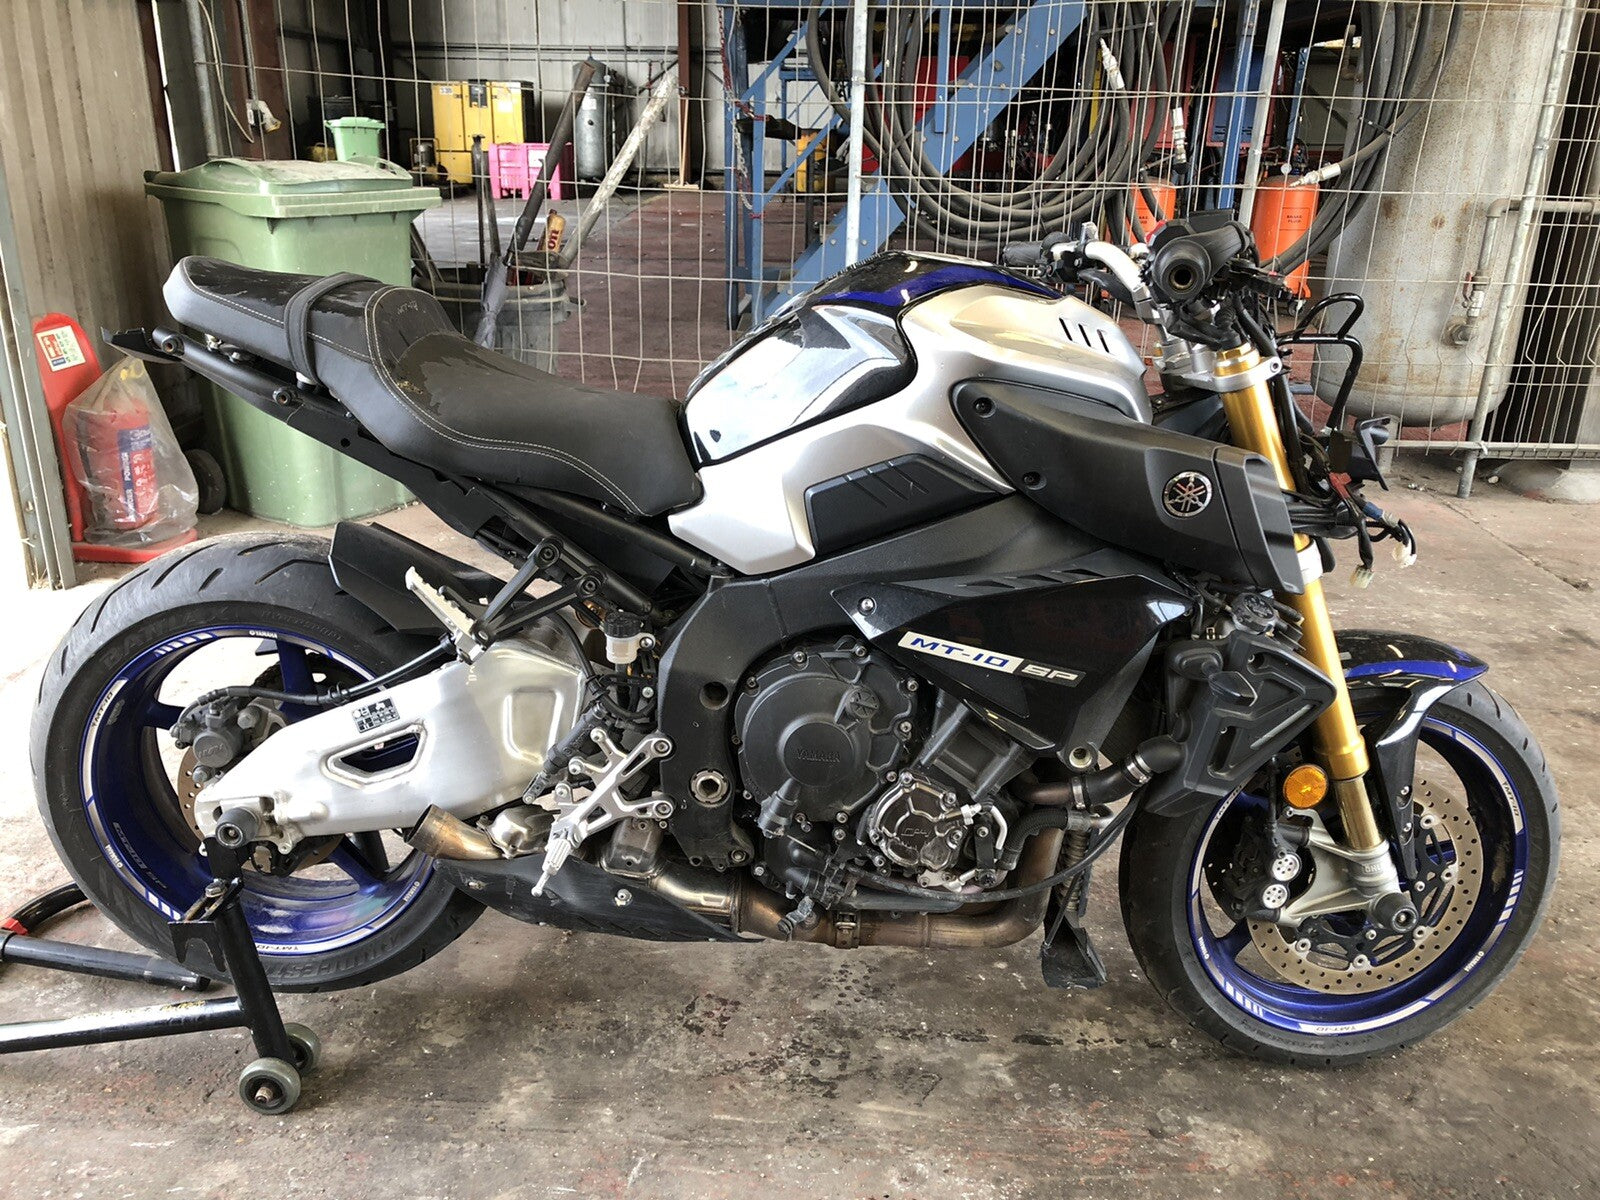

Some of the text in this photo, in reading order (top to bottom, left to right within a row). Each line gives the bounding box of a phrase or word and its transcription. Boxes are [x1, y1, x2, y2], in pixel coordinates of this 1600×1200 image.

[120, 451, 132, 482] POWDER
[255, 629, 278, 640] YAMAHA
[911, 637, 1079, 682] MT-10 SP
